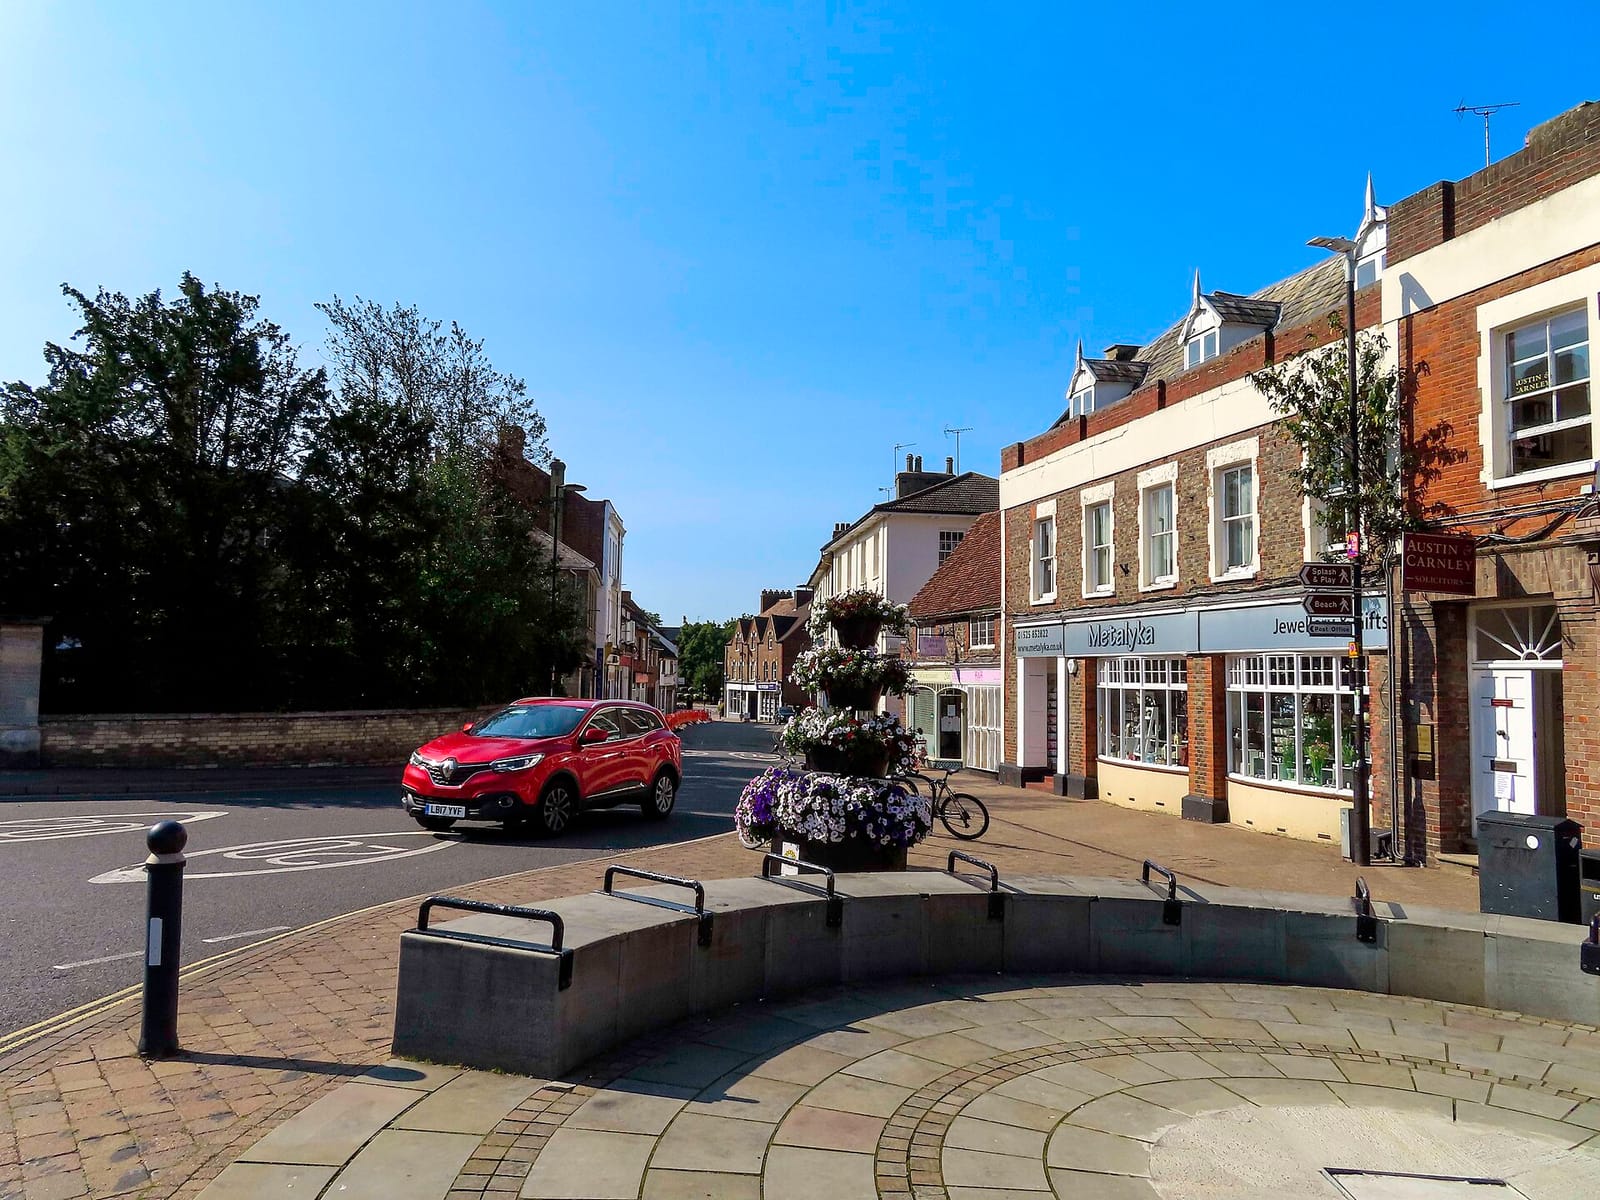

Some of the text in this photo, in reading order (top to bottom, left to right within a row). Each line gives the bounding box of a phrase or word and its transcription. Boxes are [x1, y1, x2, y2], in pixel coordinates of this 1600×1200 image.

[1407, 540, 1458, 555] AUSTIN
[1406, 554, 1473, 571] CARNLEY
[1312, 567, 1337, 576] Splash
[1320, 576, 1337, 584] Play
[1273, 610, 1388, 634] Jewel ifts
[1088, 620, 1155, 651] Metalyka
